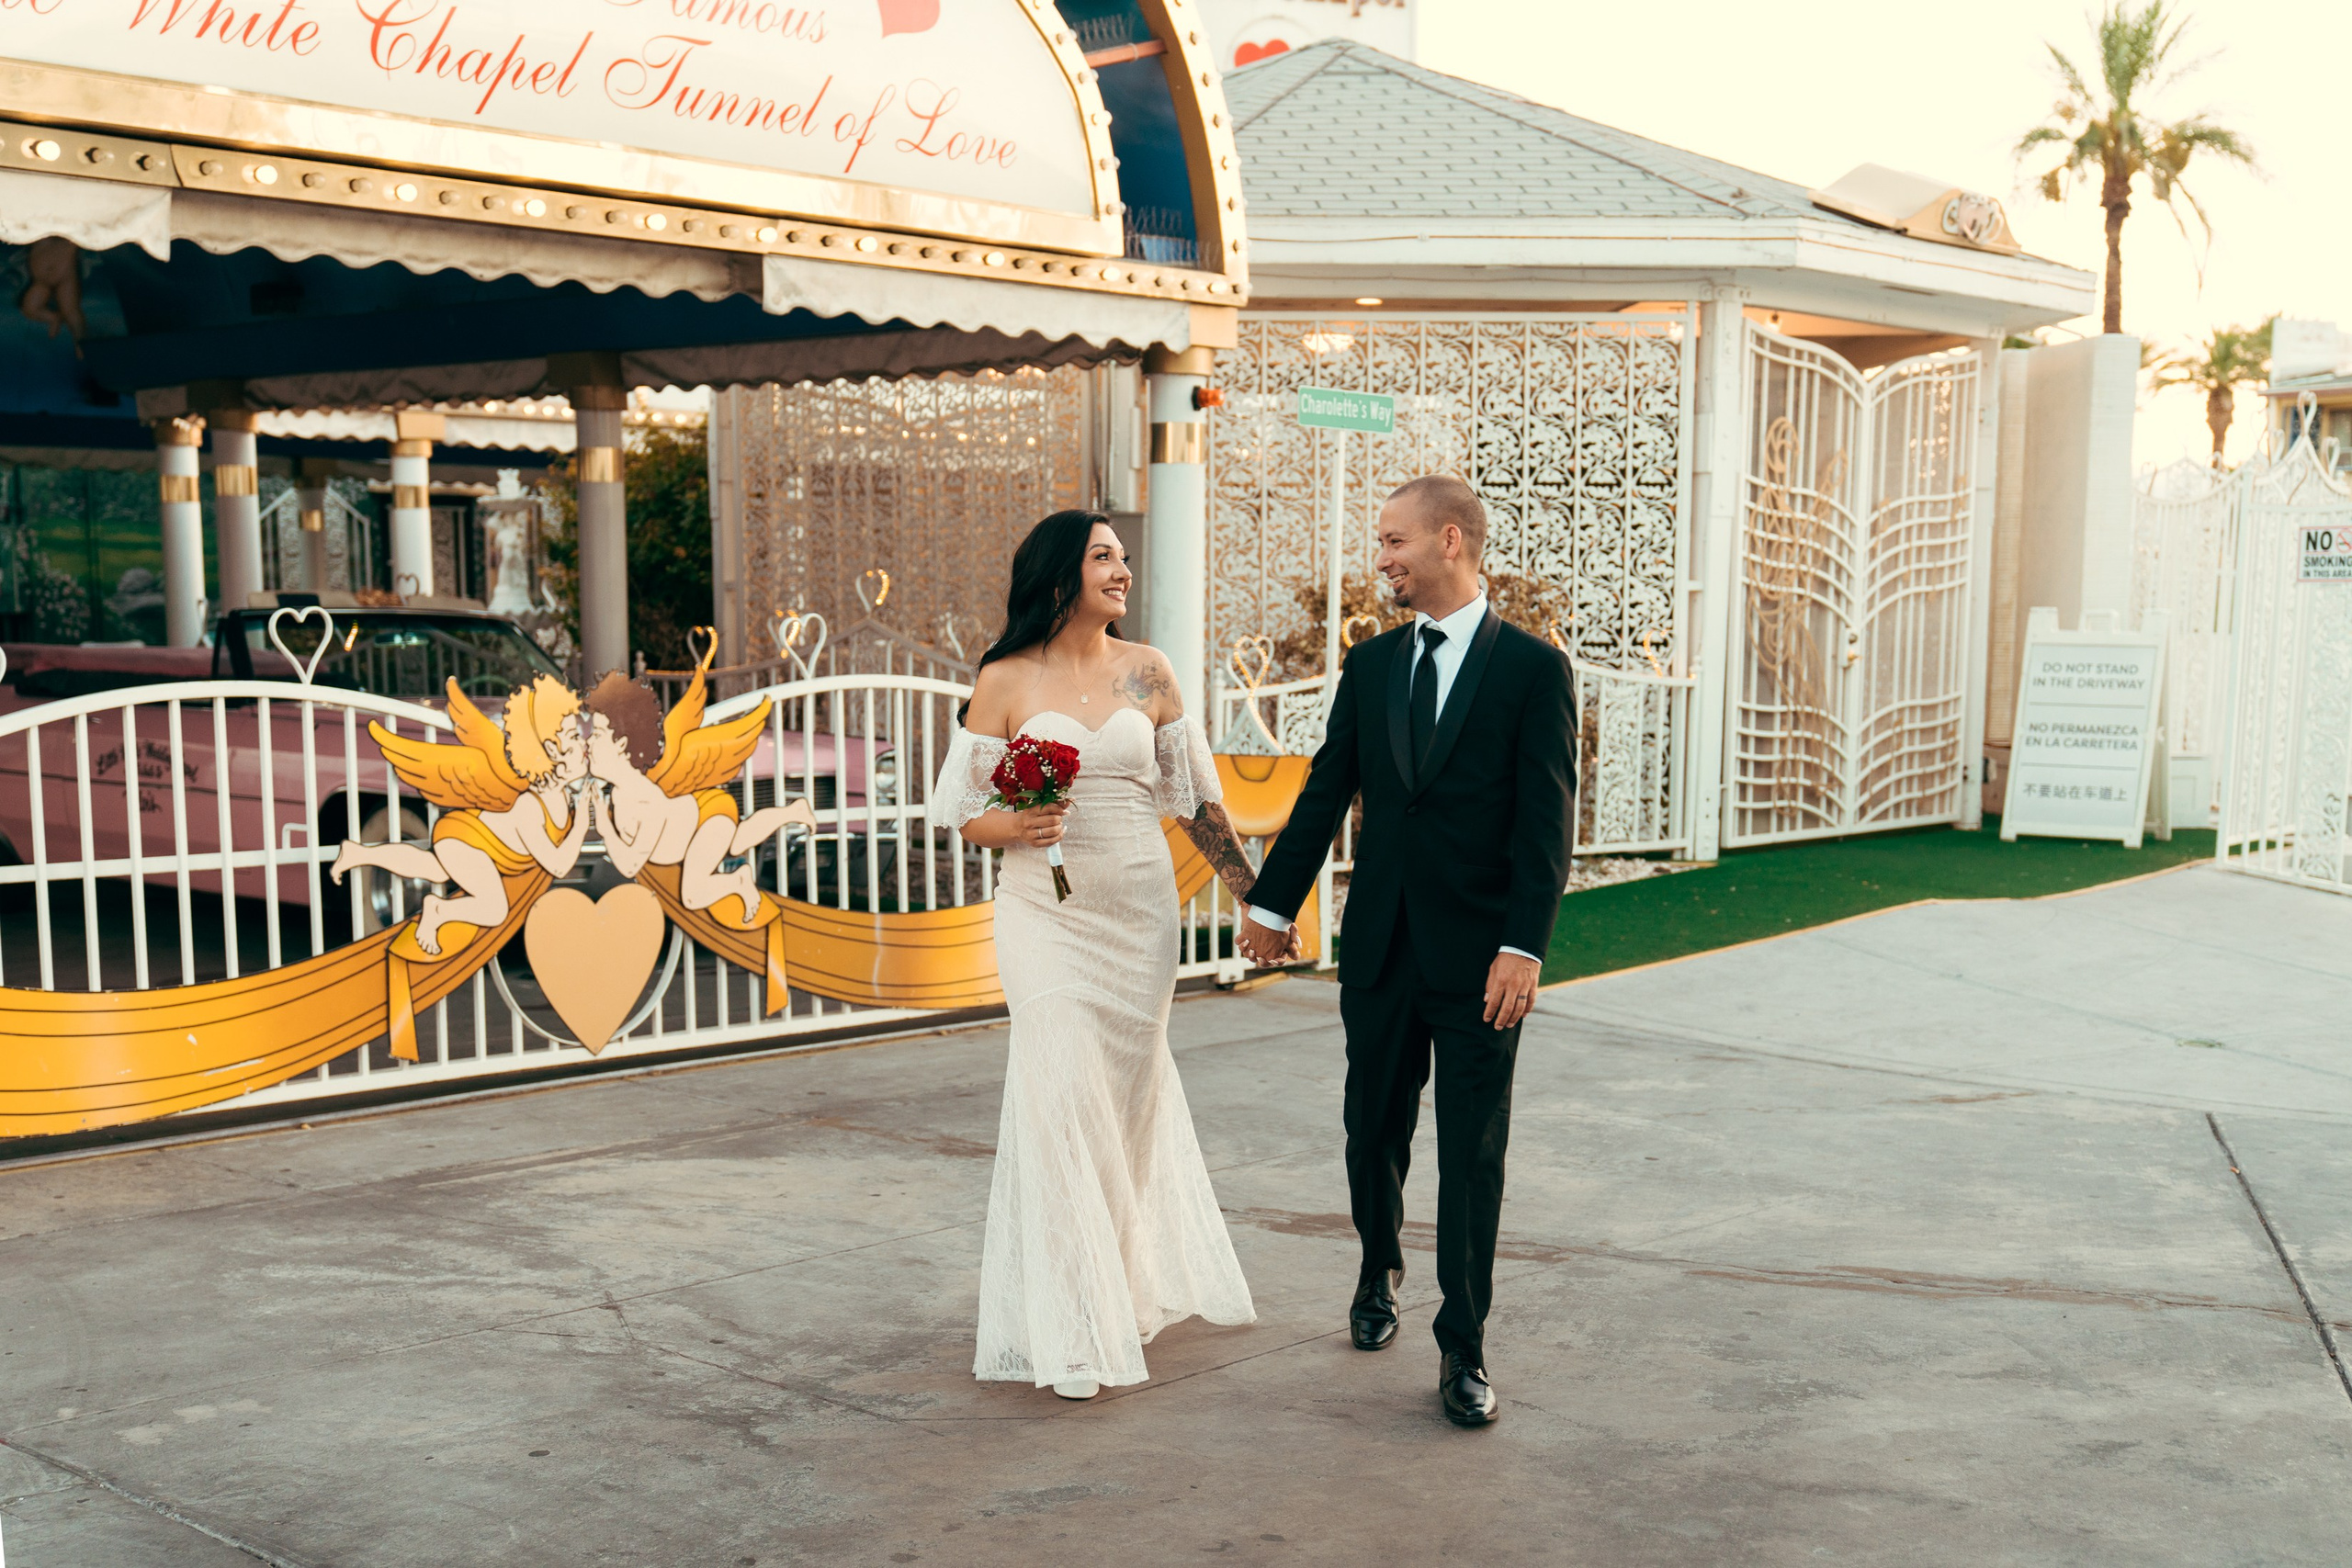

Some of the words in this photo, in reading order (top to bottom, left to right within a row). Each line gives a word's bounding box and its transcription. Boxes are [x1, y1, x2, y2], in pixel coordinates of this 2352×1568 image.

[602, 0, 829, 43] amous
[355, 0, 594, 115] Chapel
[604, 34, 833, 137] Tunnel
[833, 84, 897, 174] of
[895, 78, 1017, 169] Love
[1301, 393, 1368, 419] Charolette's
[1370, 400, 1392, 427] Way
[2306, 531, 2333, 551] NO
[2042, 661, 2063, 673] DO
[2065, 662, 2093, 673] NOT
[2096, 663, 2139, 675] STAND
[2032, 678, 2046, 687] IN
[2050, 678, 2073, 688] THE
[2077, 678, 2145, 689] DRIVEWAY
[2029, 723, 2049, 733] NO
[2052, 723, 2138, 735] PERMANEZCA
[2025, 737, 2041, 747] EN
[2045, 738, 2060, 748] LA
[2064, 738, 2138, 750] CARRETERA
